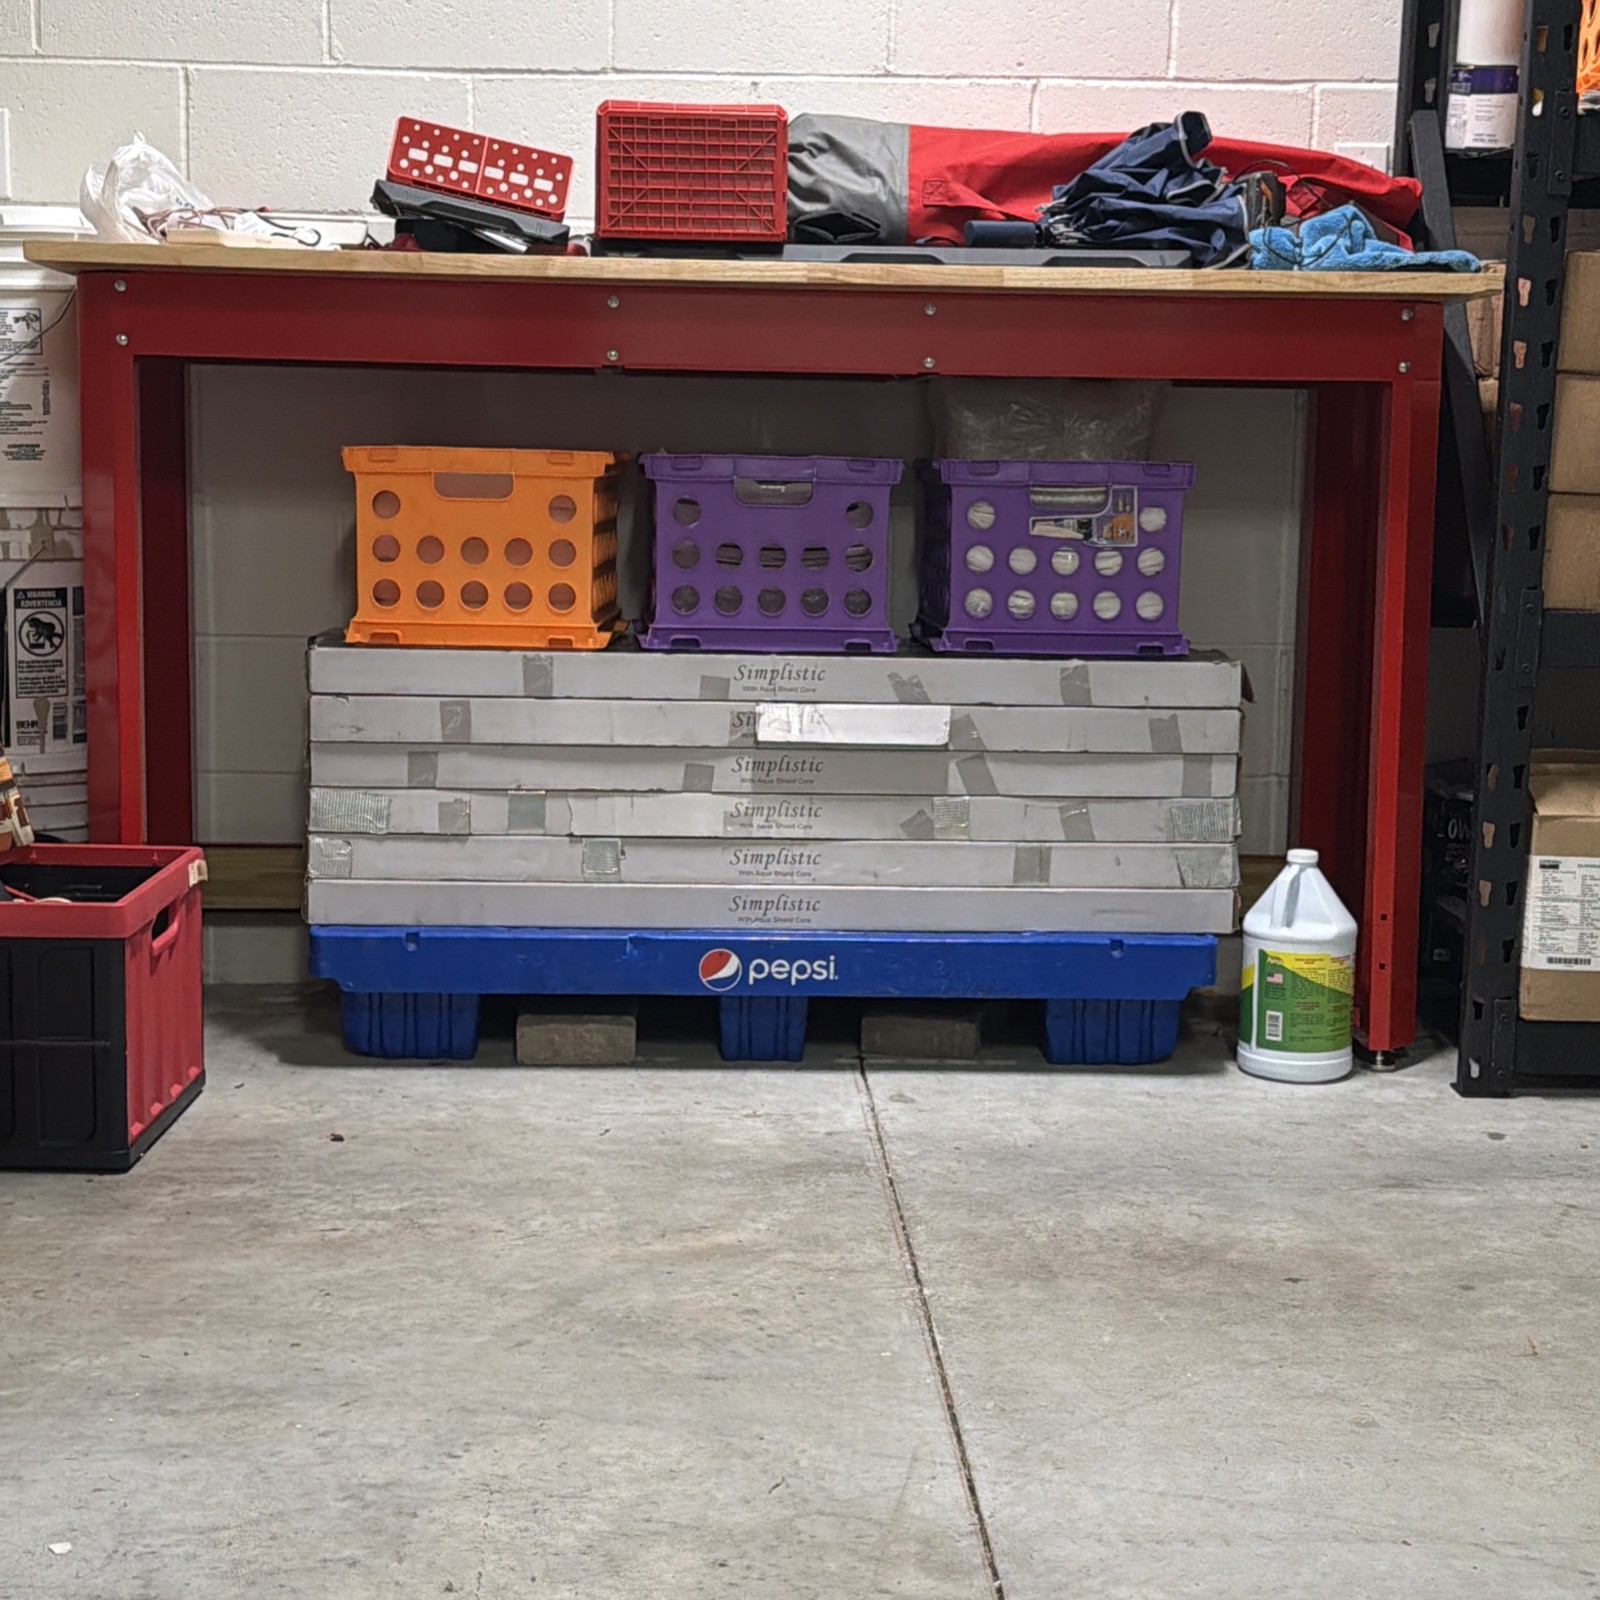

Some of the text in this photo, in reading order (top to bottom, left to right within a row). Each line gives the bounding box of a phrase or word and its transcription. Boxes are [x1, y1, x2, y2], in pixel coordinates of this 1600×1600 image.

[20, 598, 62, 607] ADVERTENCIA
[26, 590, 56, 598] WARNING
[734, 662, 826, 686] Simplistic
[16, 720, 39, 729] BEHR
[731, 754, 824, 777] Simplistic
[730, 800, 823, 823] Simplistic
[729, 848, 822, 870] Simplistic
[728, 894, 821, 916] Simplistic
[749, 955, 836, 986] pepsi
